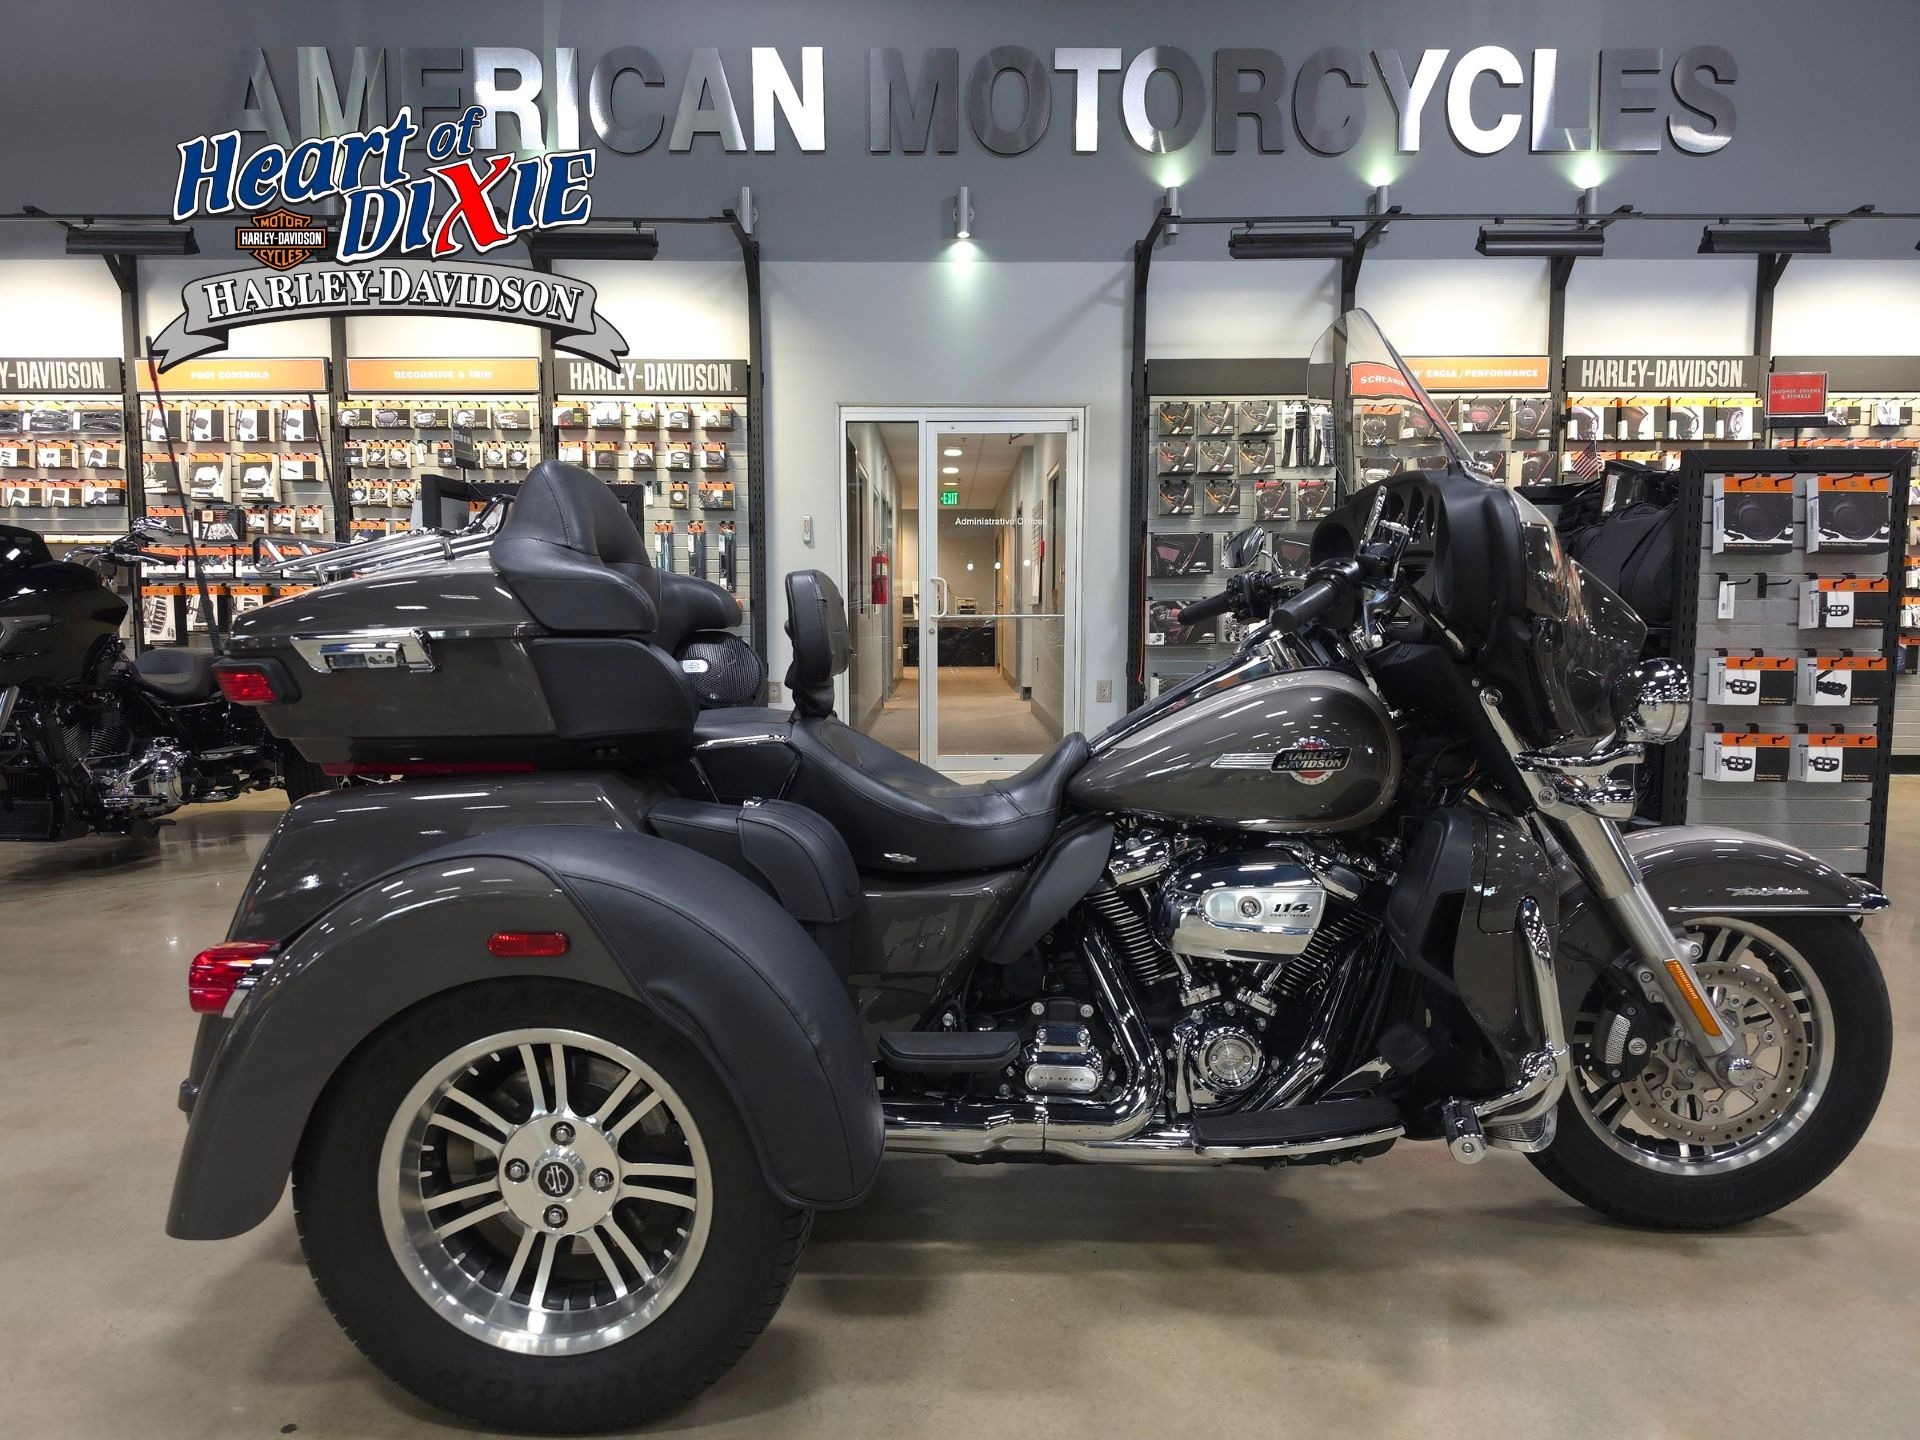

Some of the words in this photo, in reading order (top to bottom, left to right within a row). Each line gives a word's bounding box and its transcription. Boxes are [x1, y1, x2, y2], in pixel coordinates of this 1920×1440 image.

[230, 46, 826, 153] AMERICAN
[869, 46, 1738, 156] MOTORCYCLES
[191, 370, 215, 380] FOOT
[218, 370, 269, 380] CONTROLS
[393, 370, 454, 379] DECORATIVE
[458, 370, 465, 379] &
[468, 370, 494, 379] TRIM
[569, 362, 732, 391] HARLEY-DAVIDSON
[1581, 359, 1743, 388] HARLEY-DAVIDSON
[943, 492, 958, 505] EXIT
[955, 517, 1015, 526] Administrative
[1273, 903, 1312, 913] 114
